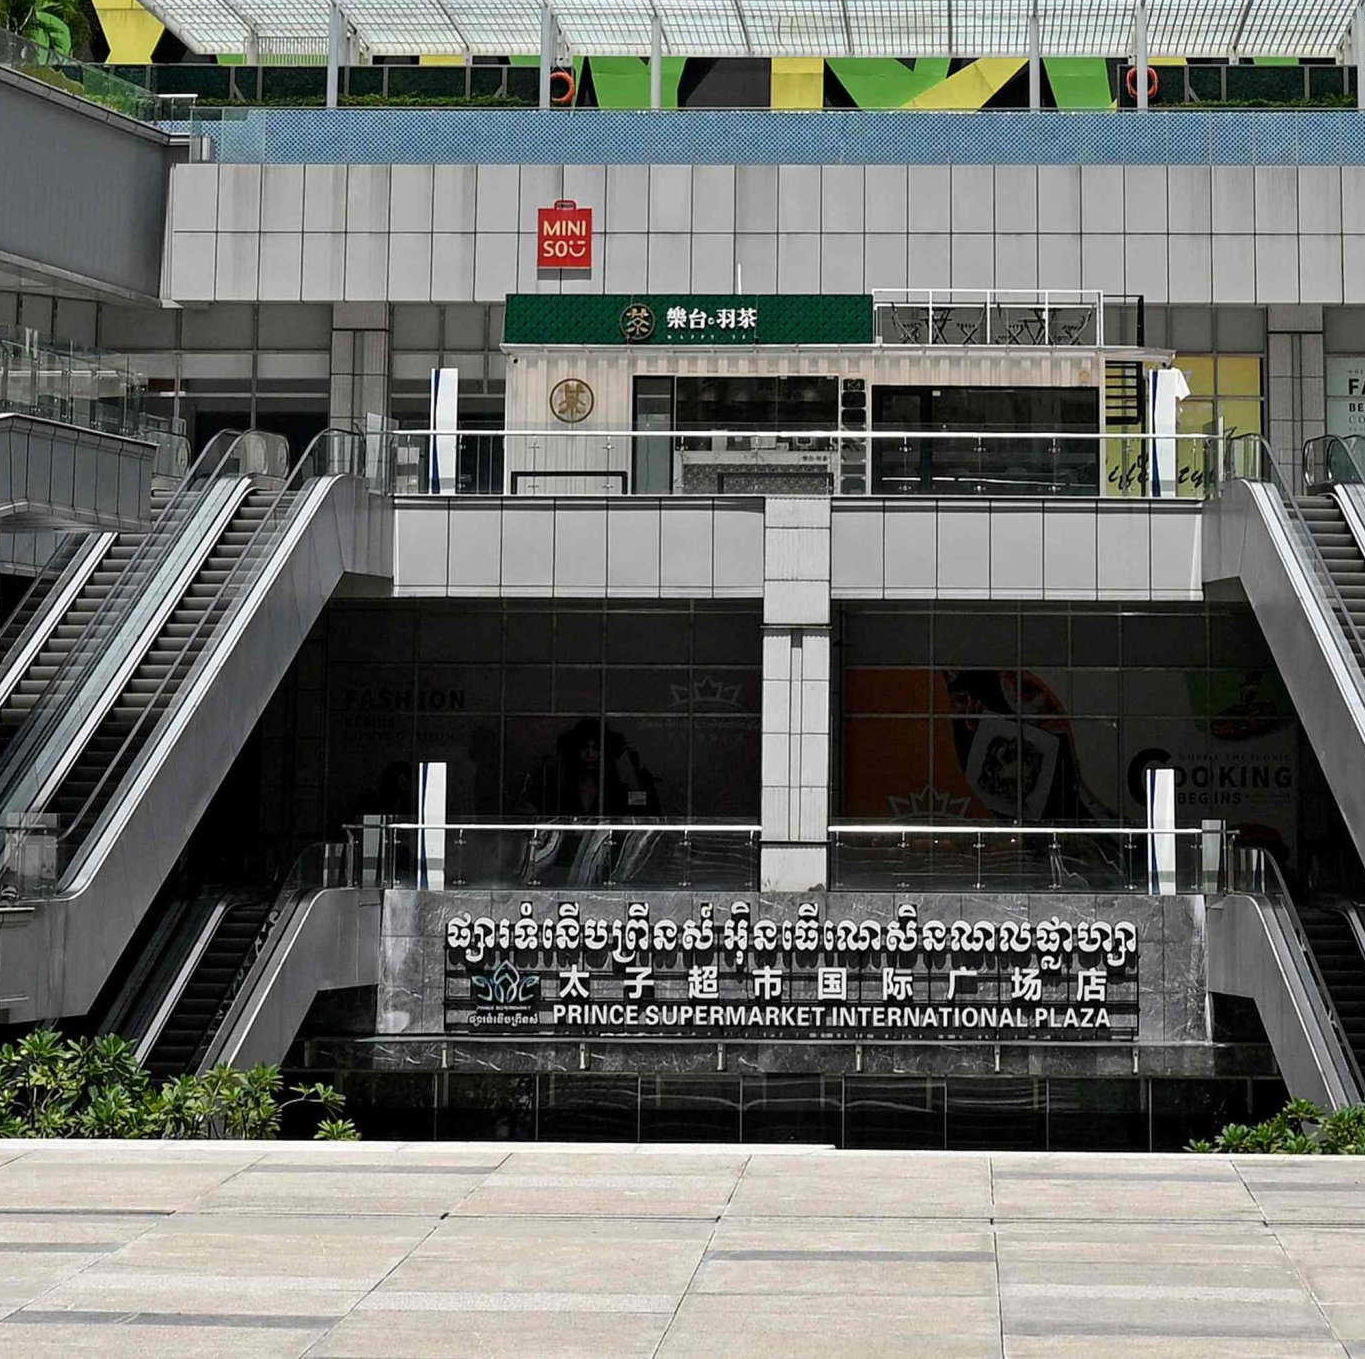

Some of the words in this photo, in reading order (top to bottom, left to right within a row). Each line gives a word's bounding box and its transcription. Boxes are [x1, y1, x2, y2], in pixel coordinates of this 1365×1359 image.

[543, 220, 586, 236] MINI
[345, 689, 465, 709] FASHION
[1127, 747, 1293, 808] COOKING
[1176, 791, 1242, 805] BEGINS
[559, 965, 1108, 1002] 太子超市国际广场店
[552, 1004, 639, 1026] PRINCE
[644, 1004, 826, 1027] SUPERMARKET
[831, 1006, 1029, 1028] INTERNATIONAL
[1034, 1007, 1112, 1029] PLAZA
